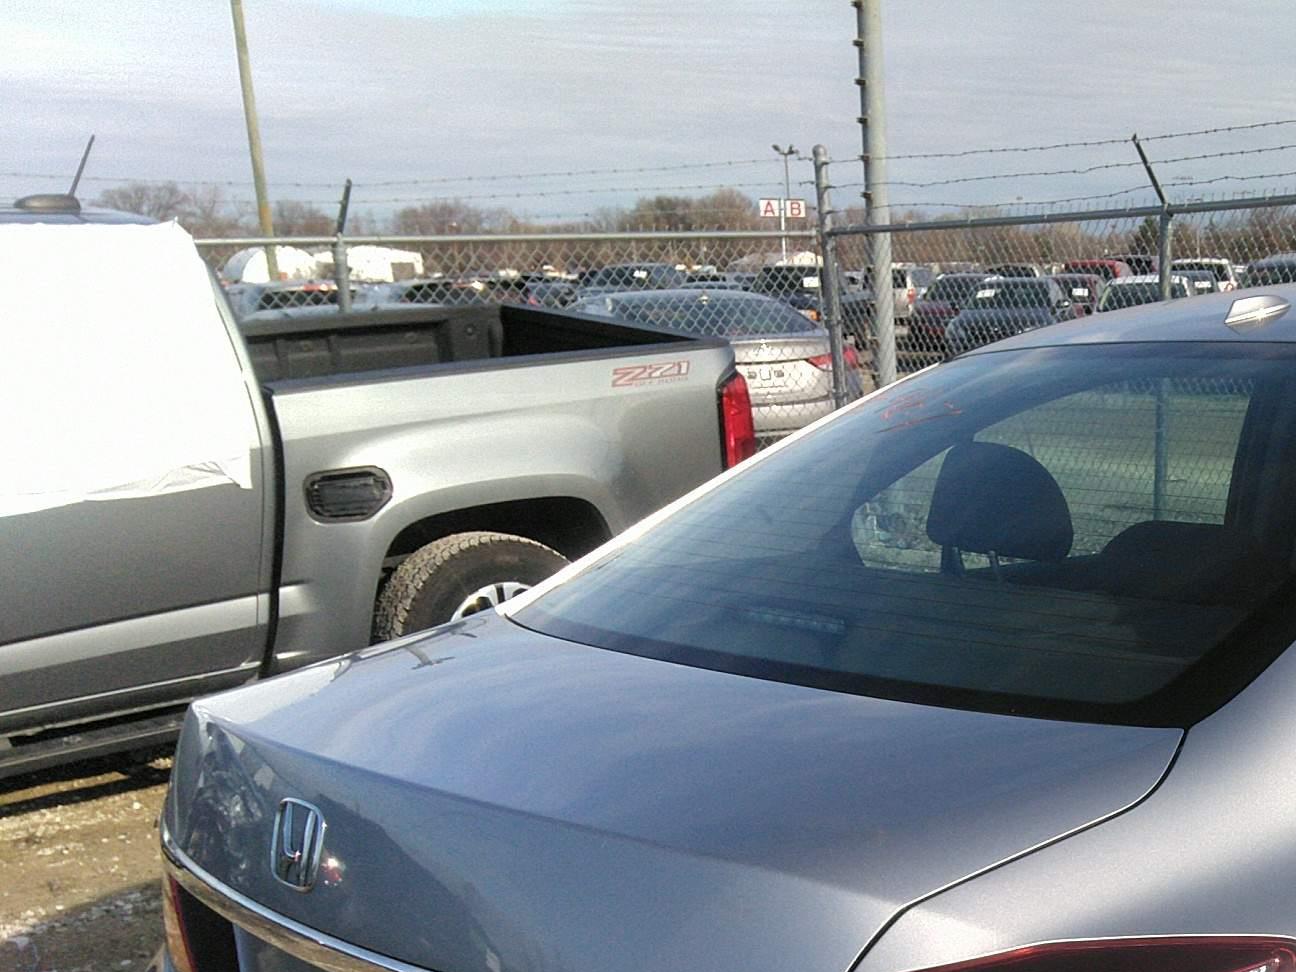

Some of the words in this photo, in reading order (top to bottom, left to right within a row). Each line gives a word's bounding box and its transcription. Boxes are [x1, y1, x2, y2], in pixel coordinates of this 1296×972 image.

[764, 201, 775, 216] A
[790, 202, 801, 216] B
[611, 360, 690, 388] Z71
